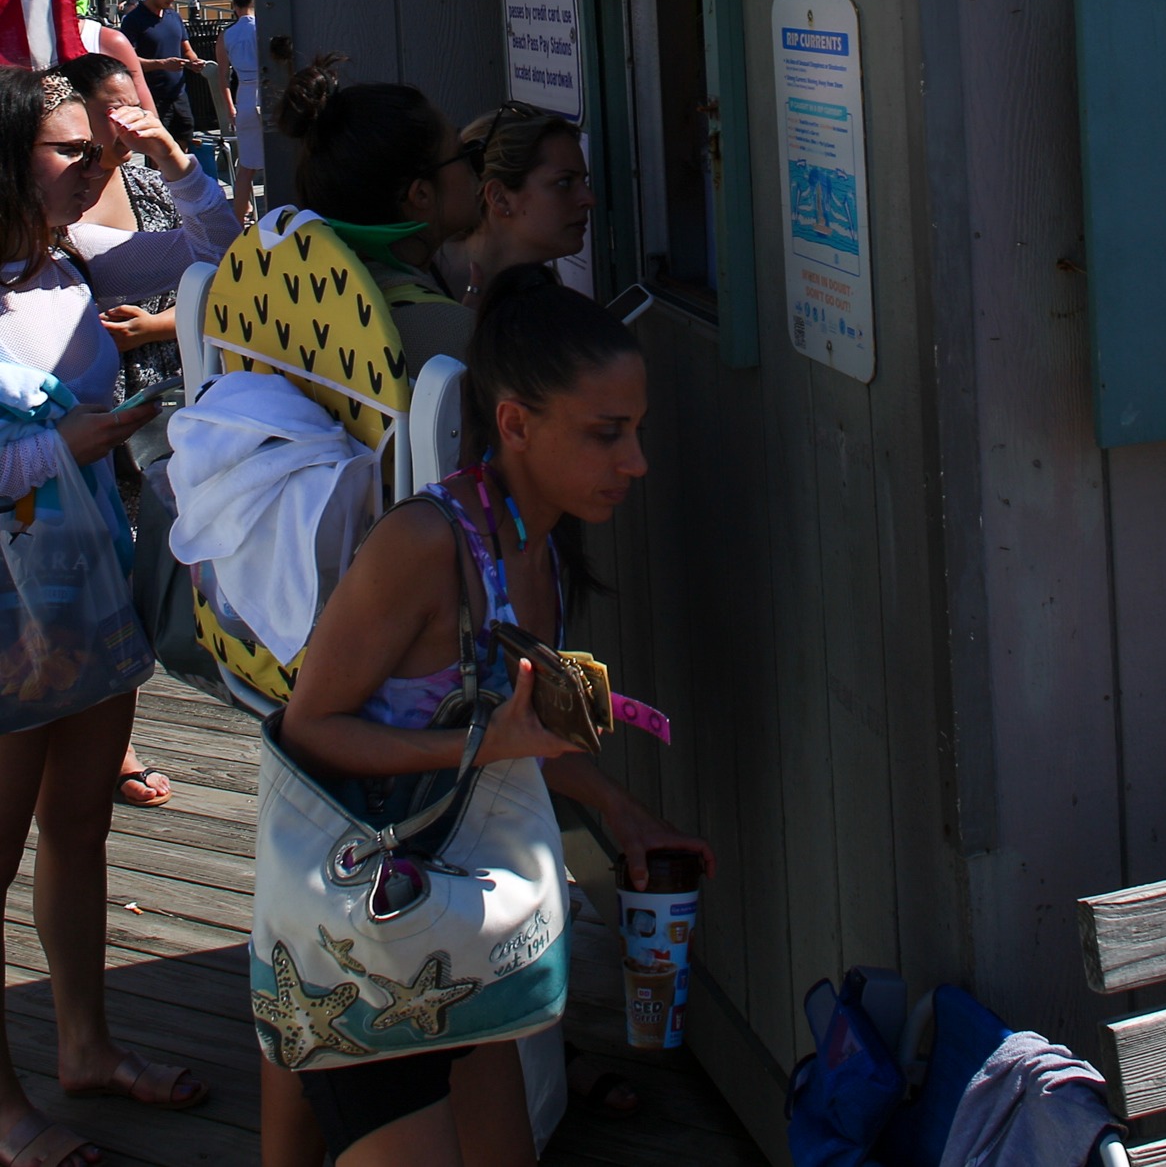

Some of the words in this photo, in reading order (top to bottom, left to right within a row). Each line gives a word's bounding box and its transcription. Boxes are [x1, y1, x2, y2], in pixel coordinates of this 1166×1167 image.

[508, 5, 525, 20] passes
[525, 2, 531, 25] by
[532, 4, 548, 21] credit
[562, 9, 572, 24] use
[512, 35, 526, 50] Beach
[526, 34, 539, 51] Pass
[539, 34, 550, 59] Pay
[550, 36, 572, 56] Stations
[786, 32, 799, 47] RIP
[799, 33, 842, 51] CURRENTS
[514, 63, 532, 81] located
[532, 65, 546, 89] along
[546, 68, 573, 89] boardwalk
